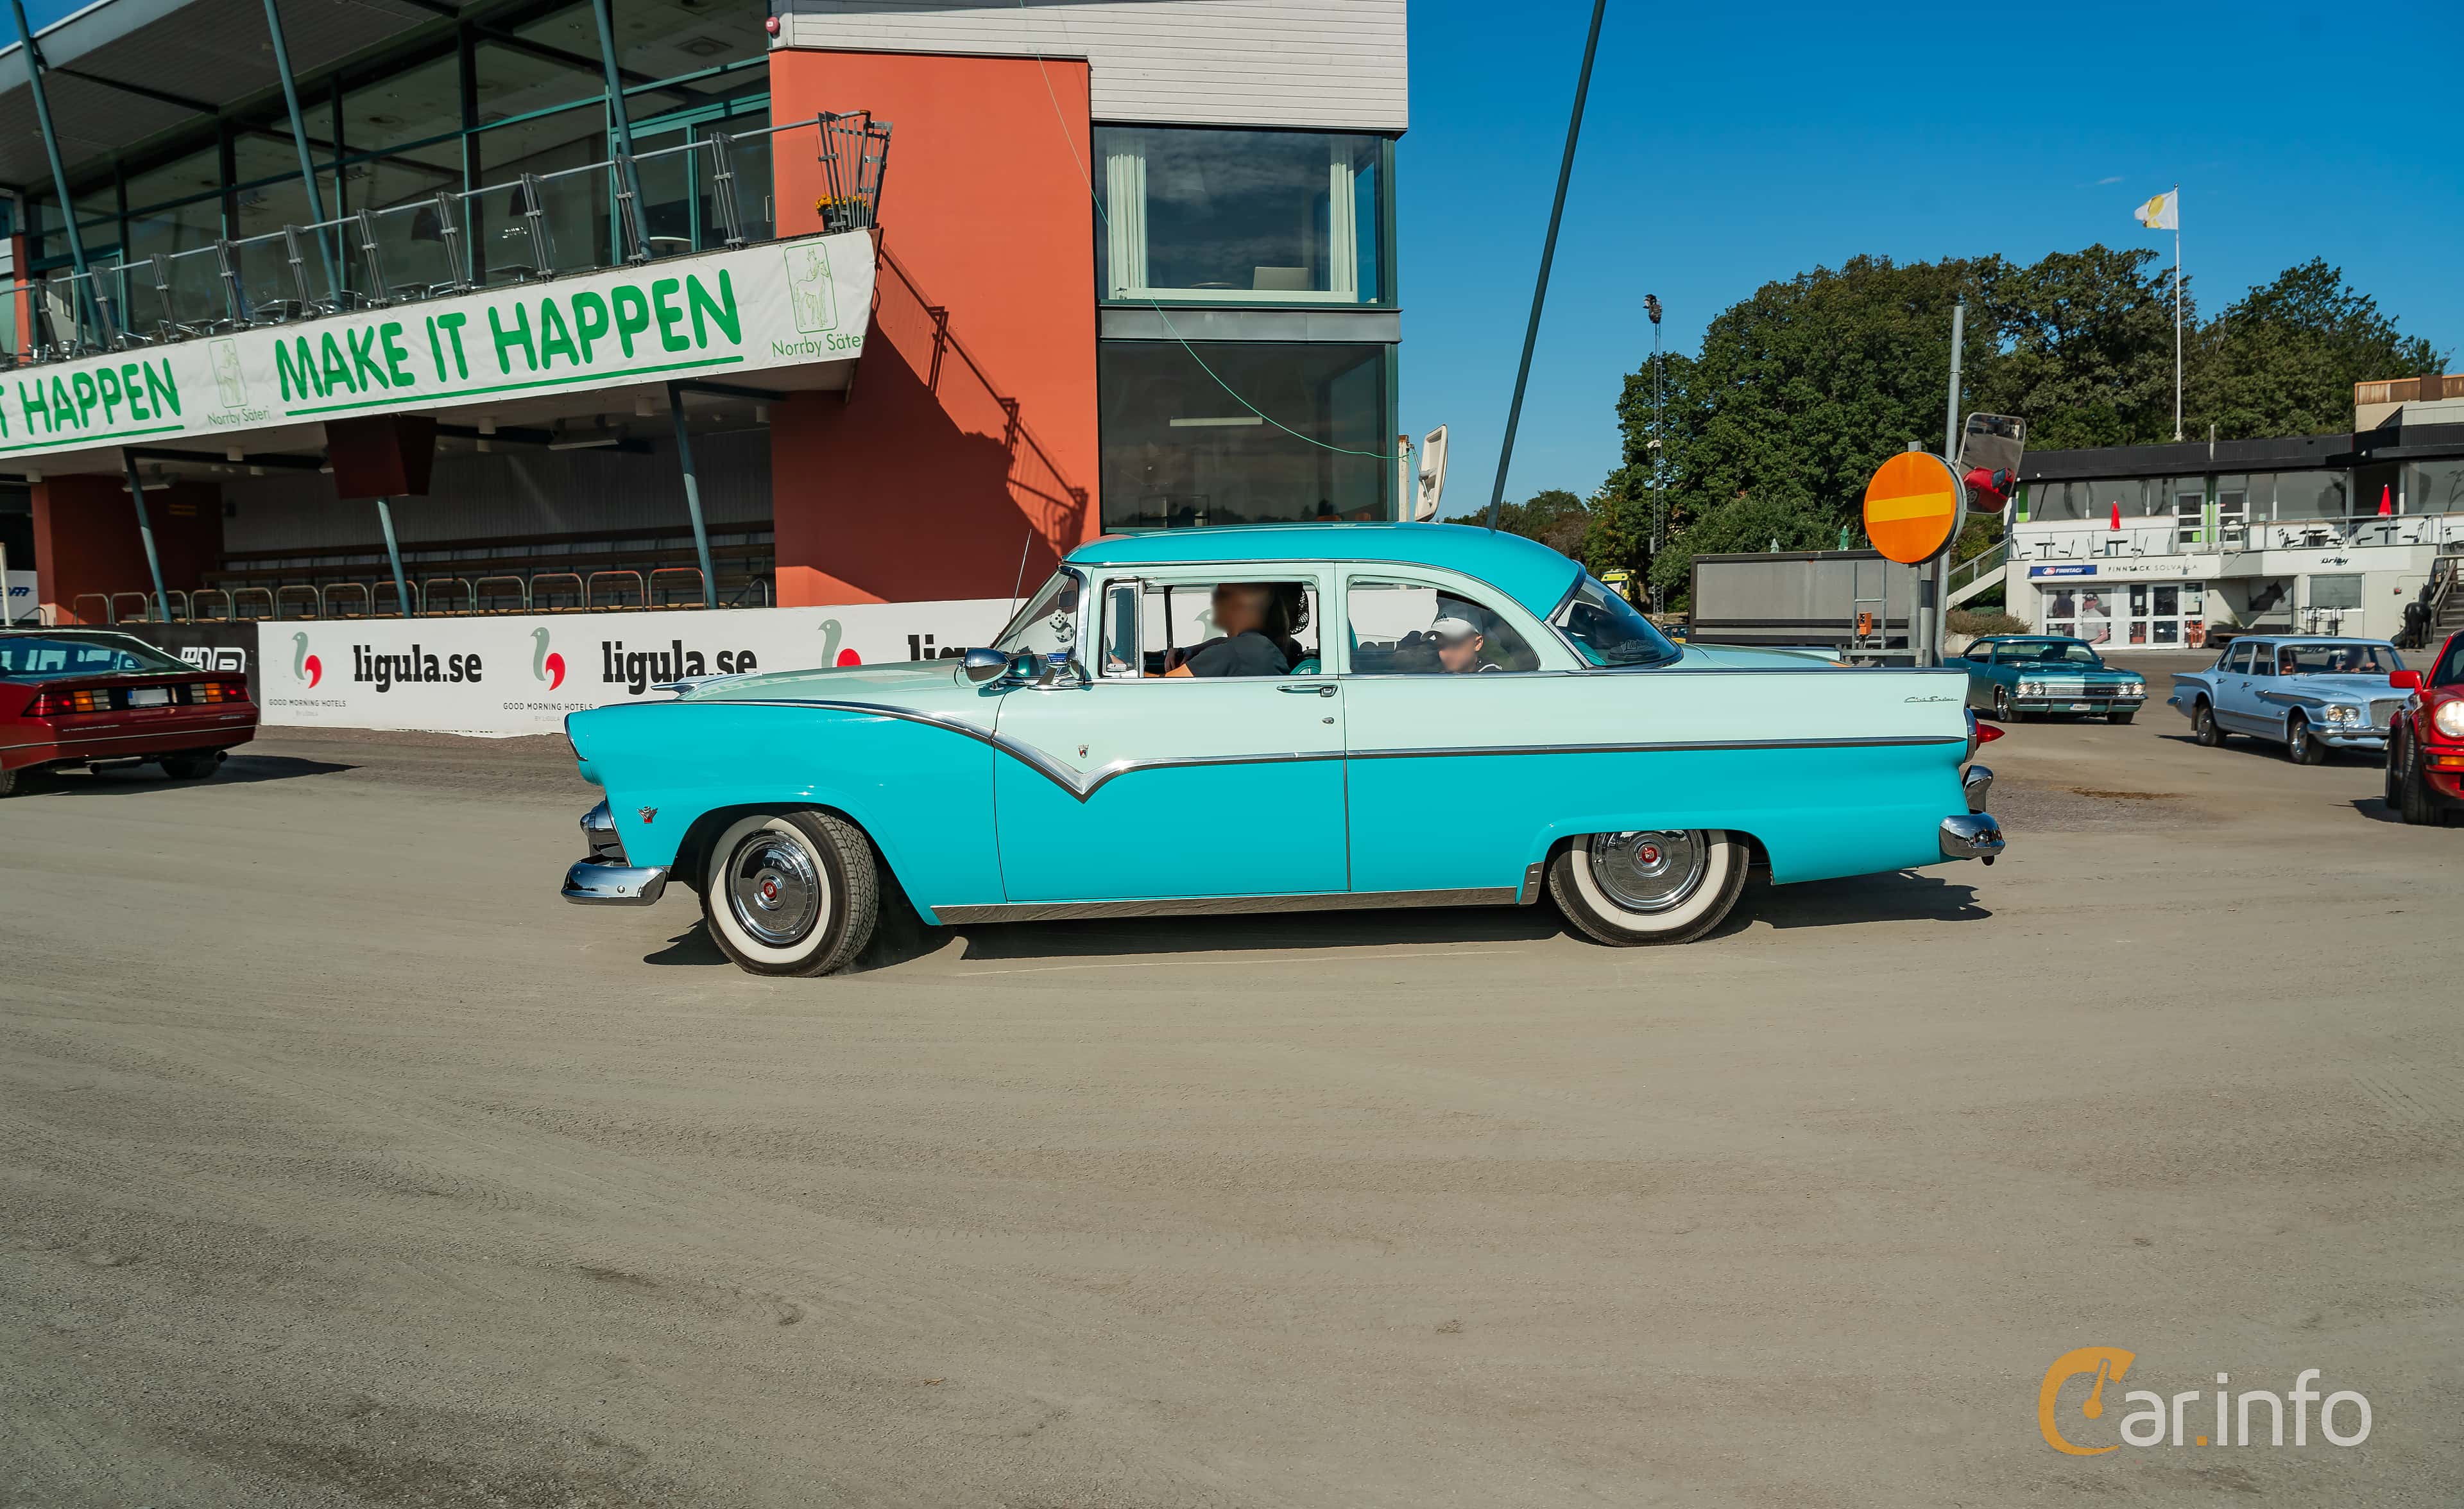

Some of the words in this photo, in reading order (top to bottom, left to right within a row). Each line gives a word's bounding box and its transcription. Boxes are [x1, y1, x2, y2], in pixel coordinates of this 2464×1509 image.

[275, 322, 415, 402] MAKE
[425, 312, 469, 383] IT
[488, 268, 742, 375] HAPPEN
[771, 336, 822, 358] Norrby
[18, 358, 182, 435] HAPPEN
[207, 410, 241, 427] Norrby
[353, 644, 483, 693] ligula.se
[602, 639, 757, 695] ligulase
